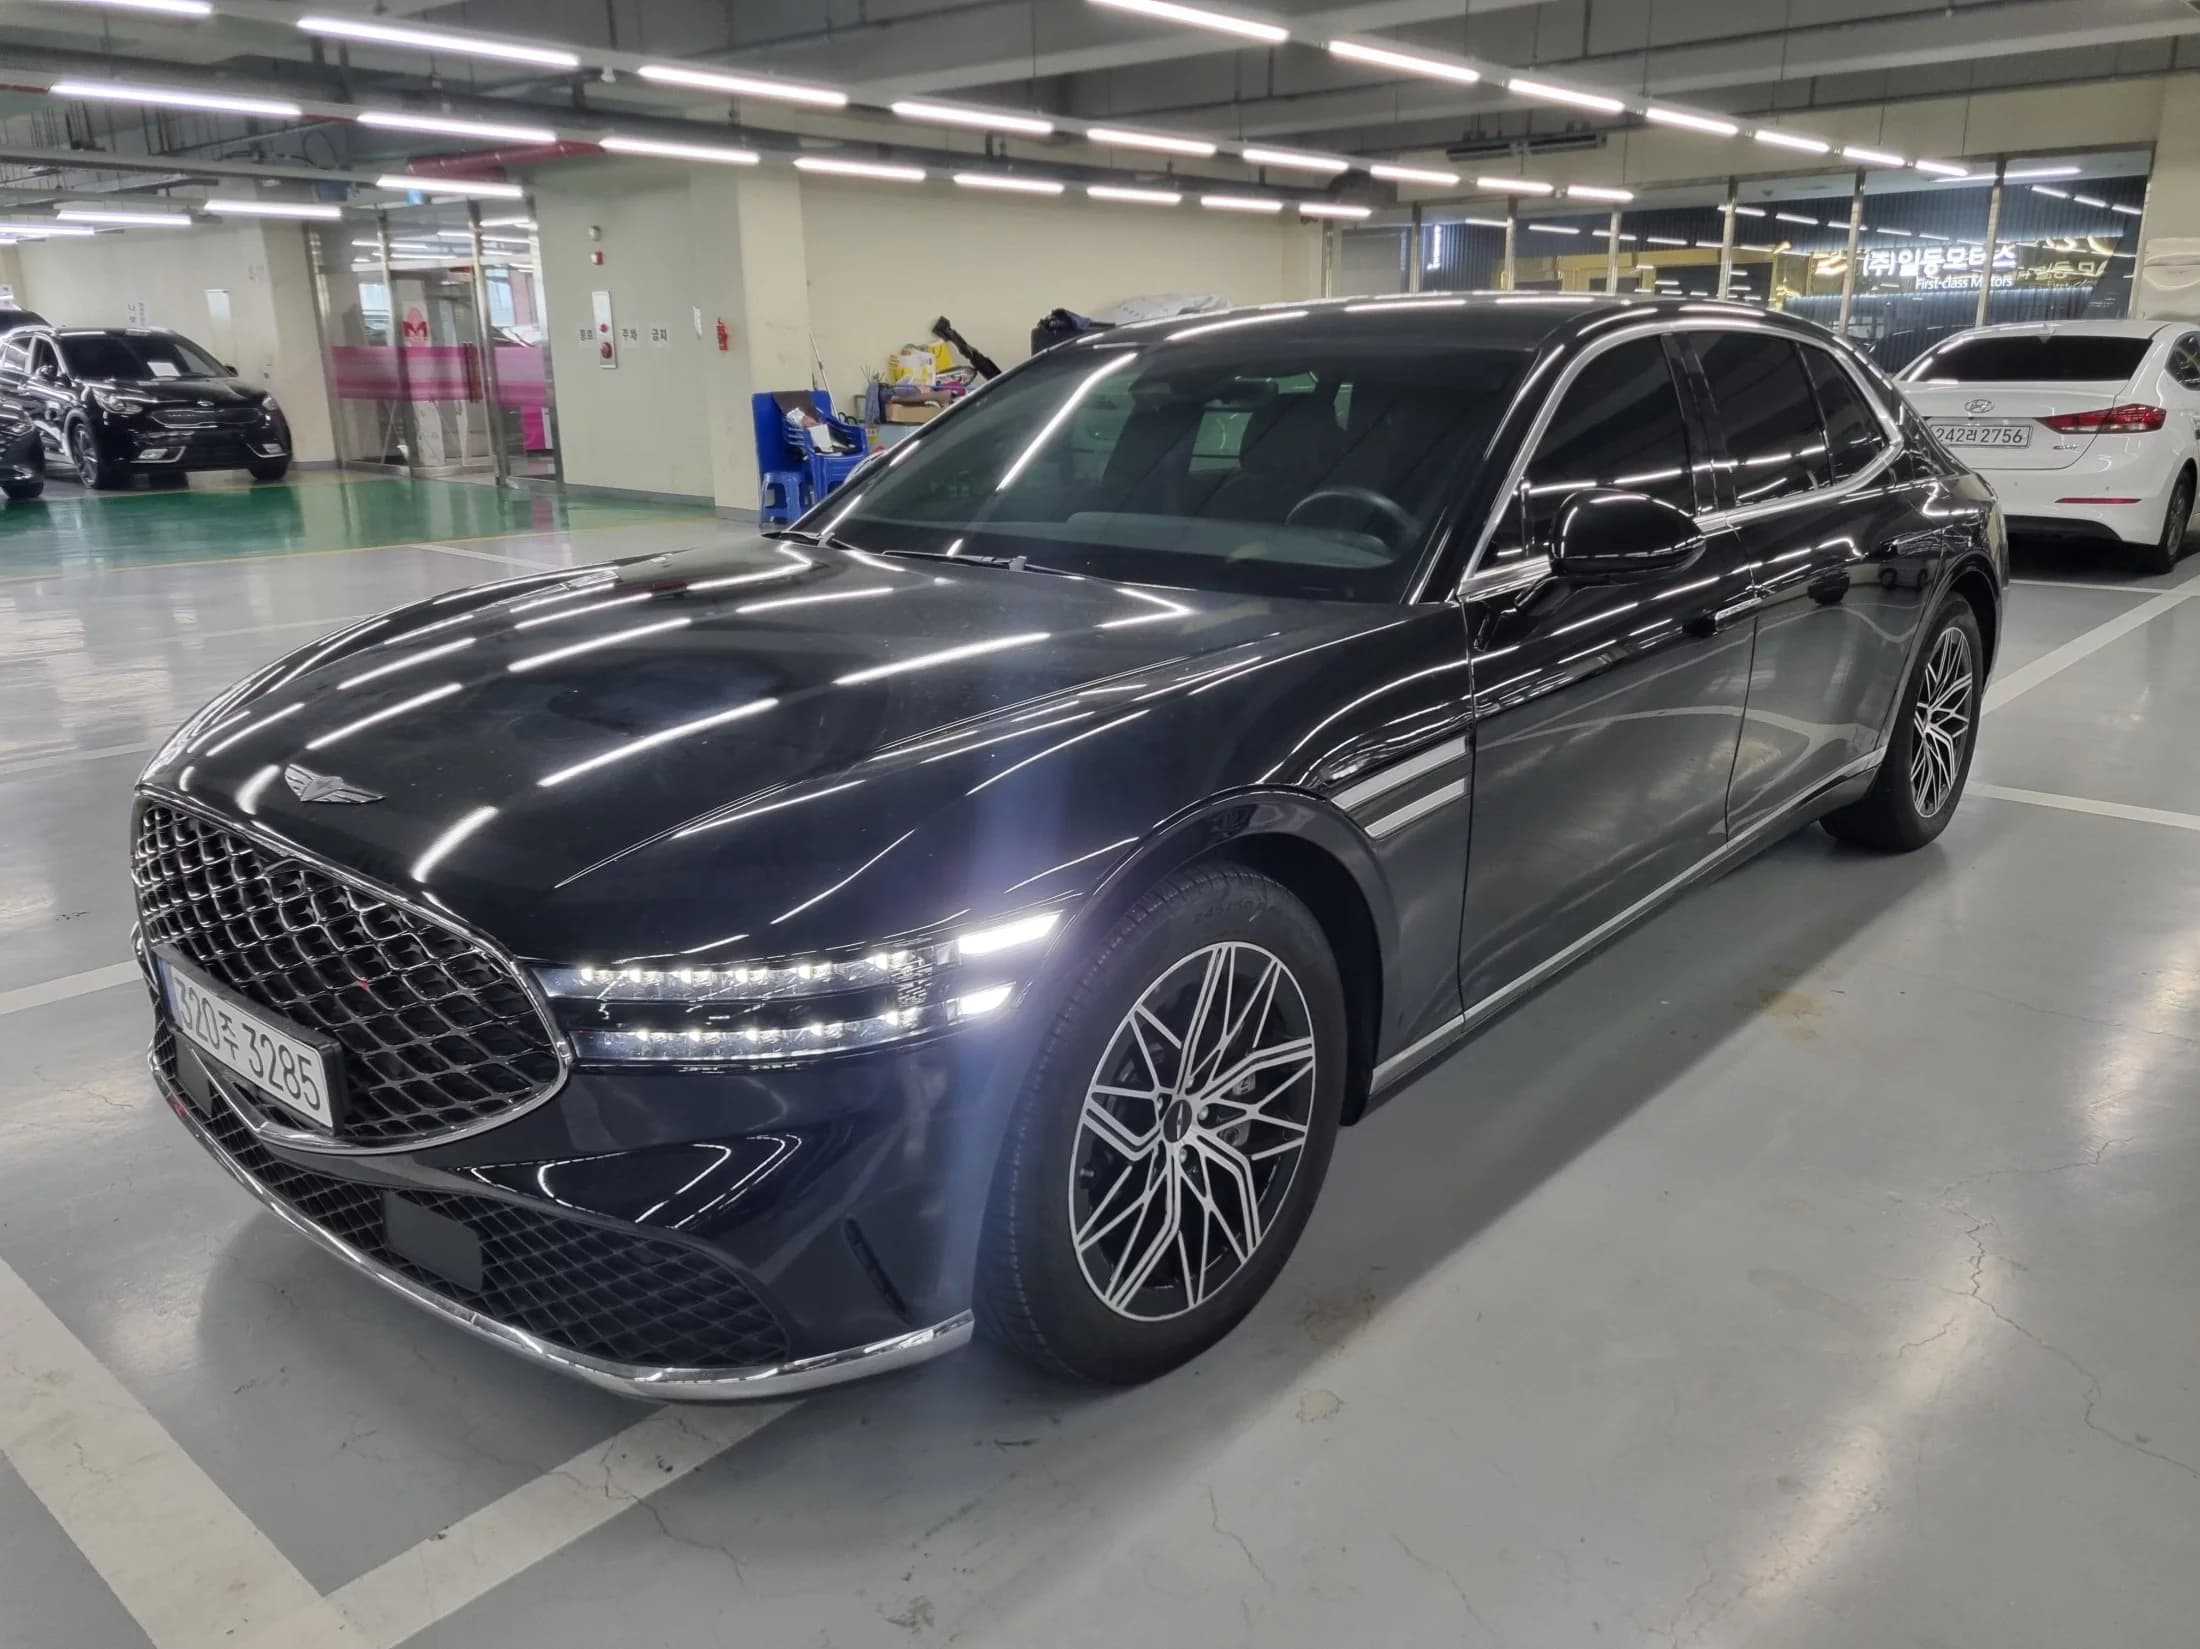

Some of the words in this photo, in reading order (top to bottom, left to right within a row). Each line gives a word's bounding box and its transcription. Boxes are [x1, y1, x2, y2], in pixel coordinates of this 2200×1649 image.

[1970, 275, 2013, 288] Mtors
[621, 328, 638, 341] 주차
[652, 328, 668, 341] 금지
[1980, 428, 2023, 444] 2756
[174, 976, 239, 1061] 320주
[241, 1022, 321, 1111] 3285
